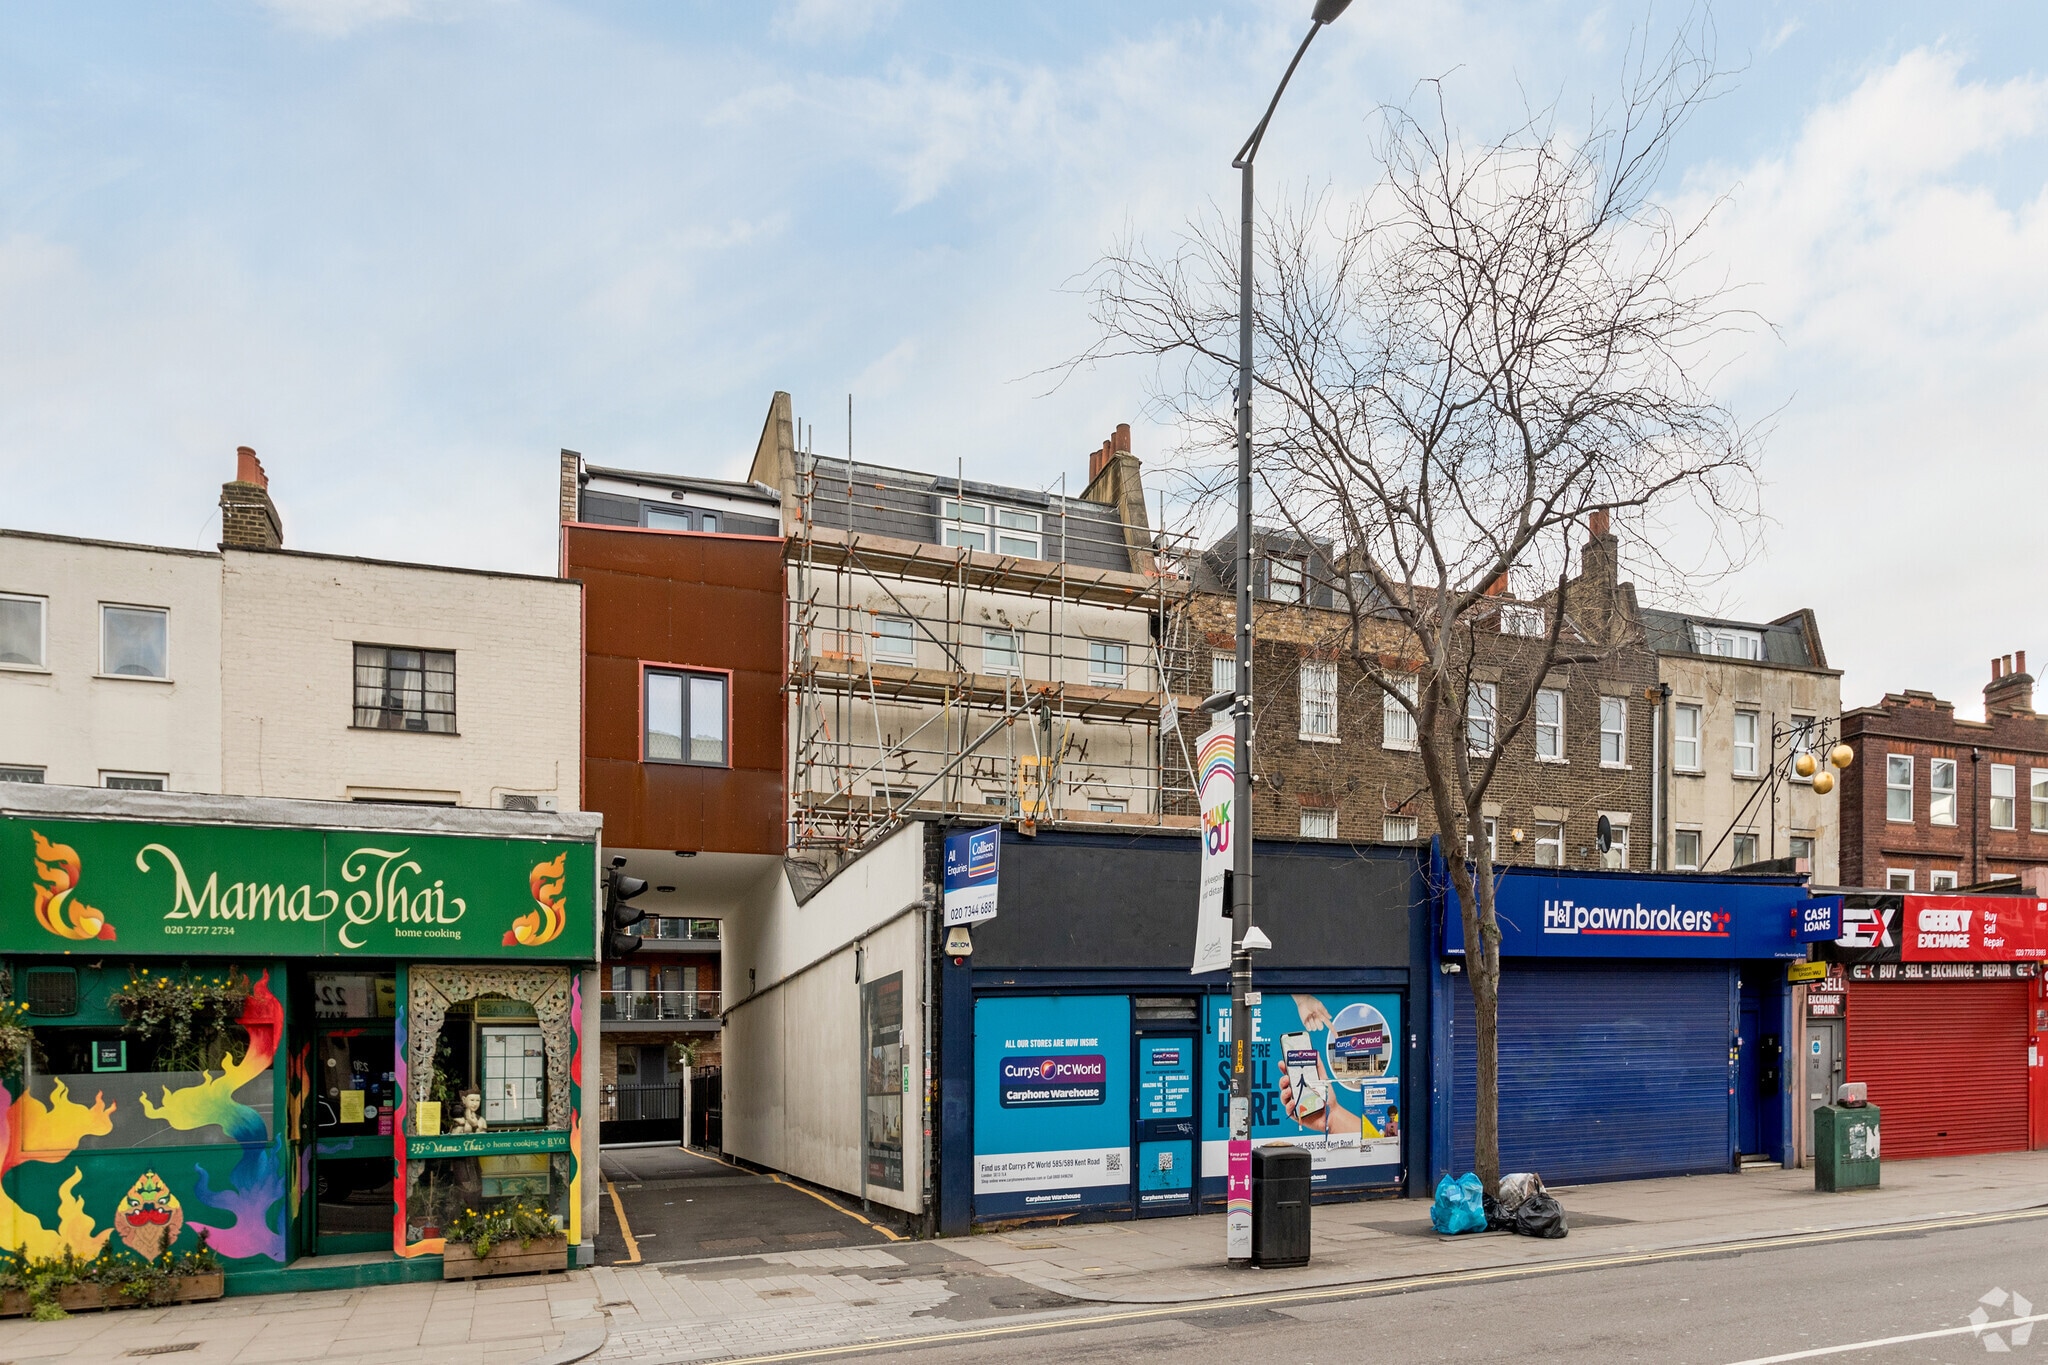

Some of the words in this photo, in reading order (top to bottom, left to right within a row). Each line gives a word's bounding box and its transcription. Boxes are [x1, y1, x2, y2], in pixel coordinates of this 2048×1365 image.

[1203, 800, 1231, 833] THANK
[1204, 820, 1230, 860] YOU
[972, 841, 994, 856] Colliers
[948, 850, 956, 862] All
[948, 863, 968, 876] Enquiries
[136, 843, 340, 922] Mama
[339, 847, 466, 949] Thai
[950, 907, 962, 920] 020
[964, 904, 979, 918] 7344
[981, 901, 995, 915] 6881
[1804, 907, 1831, 921] CASH
[1984, 911, 1997, 923] Buy
[1575, 903, 1712, 933] pawnbrokers
[1919, 909, 1973, 932] GEEKY
[164, 925, 184, 935] 020
[185, 925, 209, 935] 7277
[211, 926, 236, 936] 2734
[1804, 919, 1831, 932] LOANS
[1984, 923, 1996, 934] Sell
[395, 927, 423, 937] home
[424, 928, 462, 940] cooking
[1918, 933, 1970, 948] EXCHANGE
[1984, 937, 2005, 950] Repair
[1879, 964, 1897, 978] BUY
[1905, 964, 1923, 978] SELL
[1931, 964, 1974, 977] EXCHANGE
[1982, 964, 2011, 977] REPAIR
[1821, 977, 1844, 991] SELL
[1808, 994, 1840, 1004] EXCHANGE
[1218, 1008, 1229, 1017] WE
[1253, 1008, 1262, 1017] BE
[1813, 1005, 1836, 1015] REPAIR
[1005, 1040, 1016, 1048] ALL
[1017, 1039, 1029, 1048] OUR
[1030, 1039, 1052, 1048] STORES
[1053, 1039, 1064, 1047] ARE
[1065, 1038, 1079, 1047] NOW
[1080, 1038, 1099, 1046] INSIDE
[1336, 1040, 1351, 1048] Currys
[1365, 1036, 1381, 1044] World
[1218, 1044, 1232, 1058] BU
[1004, 1065, 1040, 1079] Currys
[1057, 1064, 1072, 1075] PC
[1072, 1063, 1101, 1075] World
[1218, 1060, 1272, 1090] SLL
[1006, 1089, 1050, 1101] Carphone
[1050, 1087, 1099, 1098] Warehouse
[1218, 1091, 1280, 1128] HRE
[411, 1143, 425, 1154] 235
[428, 1141, 461, 1153] Mama
[463, 1138, 487, 1151] Thai
[493, 1140, 511, 1148] home
[513, 1139, 539, 1148] cooking
[1327, 1140, 1339, 1149] Kent
[981, 1164, 993, 1172] Find
[1009, 1162, 1026, 1171] Currys
[1027, 1161, 1035, 1169] PC
[1036, 1160, 1051, 1168] World
[1052, 1159, 1074, 1168] 585/589
[1087, 1158, 1101, 1166] Road
